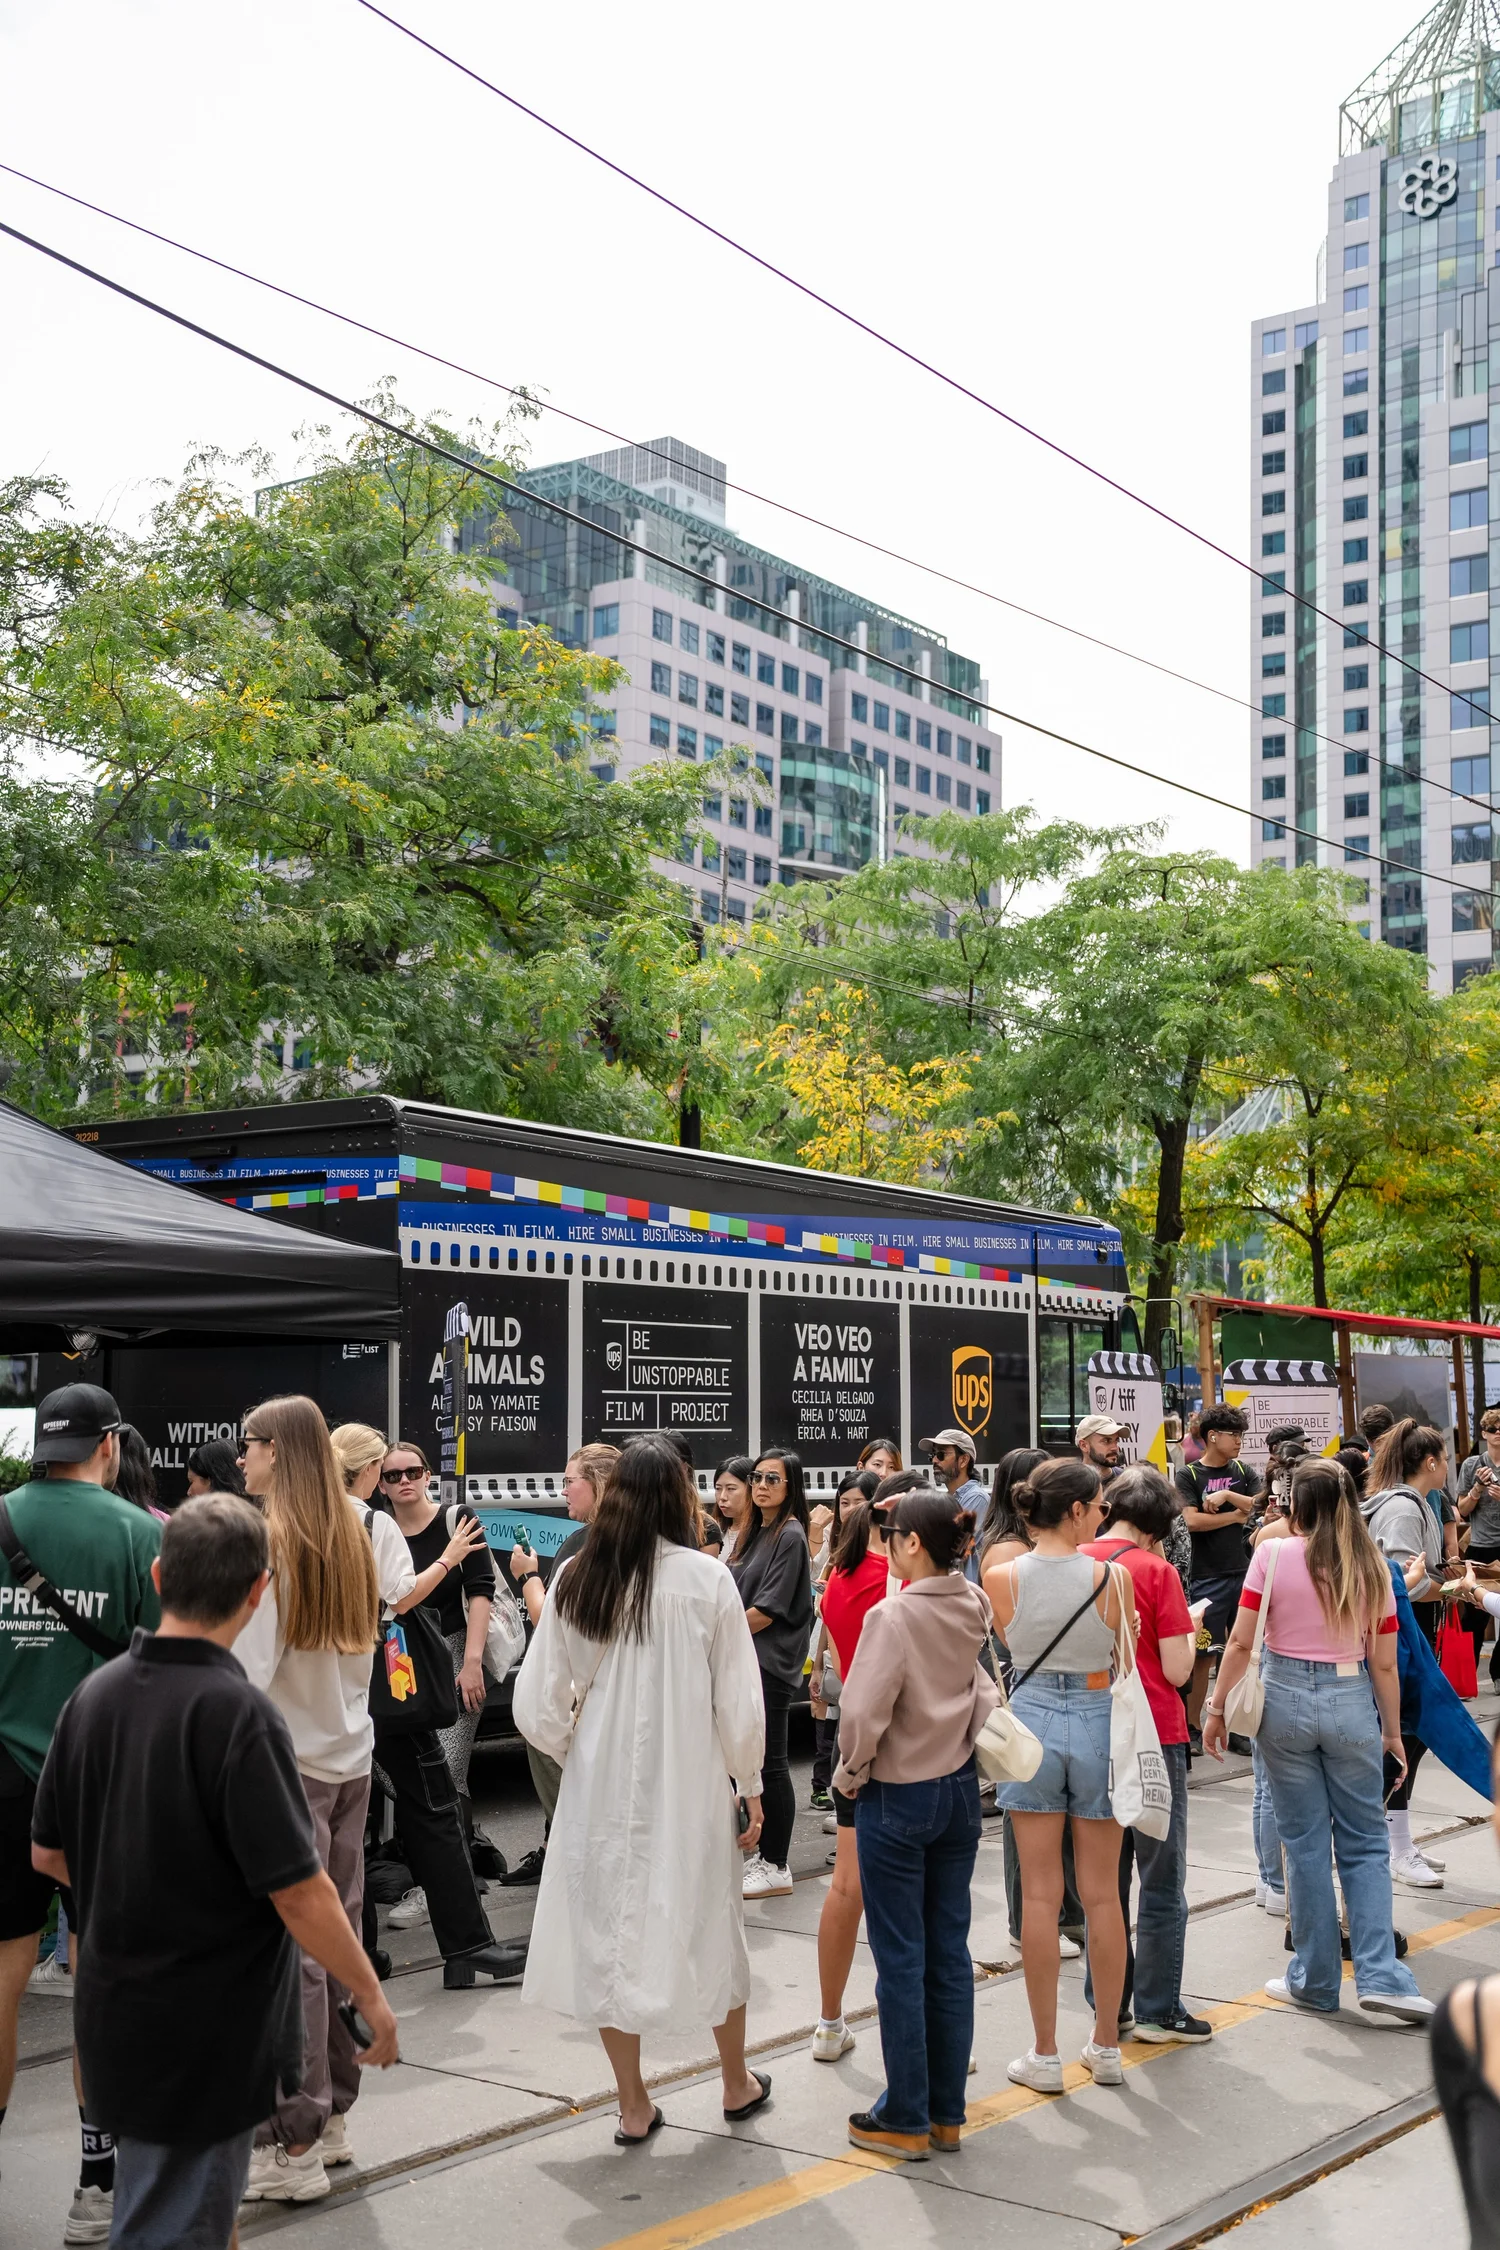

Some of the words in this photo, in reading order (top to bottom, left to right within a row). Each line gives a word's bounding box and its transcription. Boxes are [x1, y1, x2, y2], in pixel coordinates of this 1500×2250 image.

[227, 1169, 237, 1178] IN
[321, 1169, 370, 1179] USINESSES
[374, 1169, 384, 1179] IN
[524, 1225, 560, 1240] FILM.
[568, 1226, 595, 1241] HIRE
[601, 1227, 637, 1242] SMALL
[643, 1228, 704, 1243] BUSINESSES
[878, 1234, 889, 1247] IN
[923, 1235, 942, 1248] HIRE
[945, 1236, 971, 1249] SMALL
[974, 1237, 1017, 1250] BUSINESSES
[1020, 1238, 1030, 1250] IN
[1057, 1239, 1074, 1251] HIRE
[1077, 1240, 1098, 1251] SMALL
[632, 1330, 651, 1350] BE
[794, 1323, 833, 1351] VEO
[835, 1325, 872, 1352] VEO
[364, 1345, 380, 1354] LIST
[428, 1352, 545, 1386] AIMALS
[632, 1365, 730, 1387] UNSTOPPABLE
[793, 1355, 808, 1382] A
[811, 1355, 874, 1383] FAMILY
[490, 1395, 540, 1411] YAMATE
[791, 1390, 832, 1404] CECILIA
[836, 1391, 875, 1405] DELGADO
[955, 1374, 990, 1421] ups
[1118, 1387, 1136, 1412] tiff
[1257, 1400, 1271, 1411] BE
[605, 1401, 644, 1421] FILM
[671, 1402, 730, 1422] PROJECT
[800, 1408, 823, 1422] RHEA
[491, 1416, 537, 1431] FAISON
[797, 1426, 826, 1440] ERICA
[830, 1426, 841, 1440] A.
[847, 1427, 869, 1440] HART
[1207, 1477, 1232, 1492] NIKE
[538, 1531, 570, 1546] SMA
[0, 1586, 109, 1619] PREENT
[1142, 1756, 1163, 1769] MUSE
[83, 2132, 112, 2151] RE
